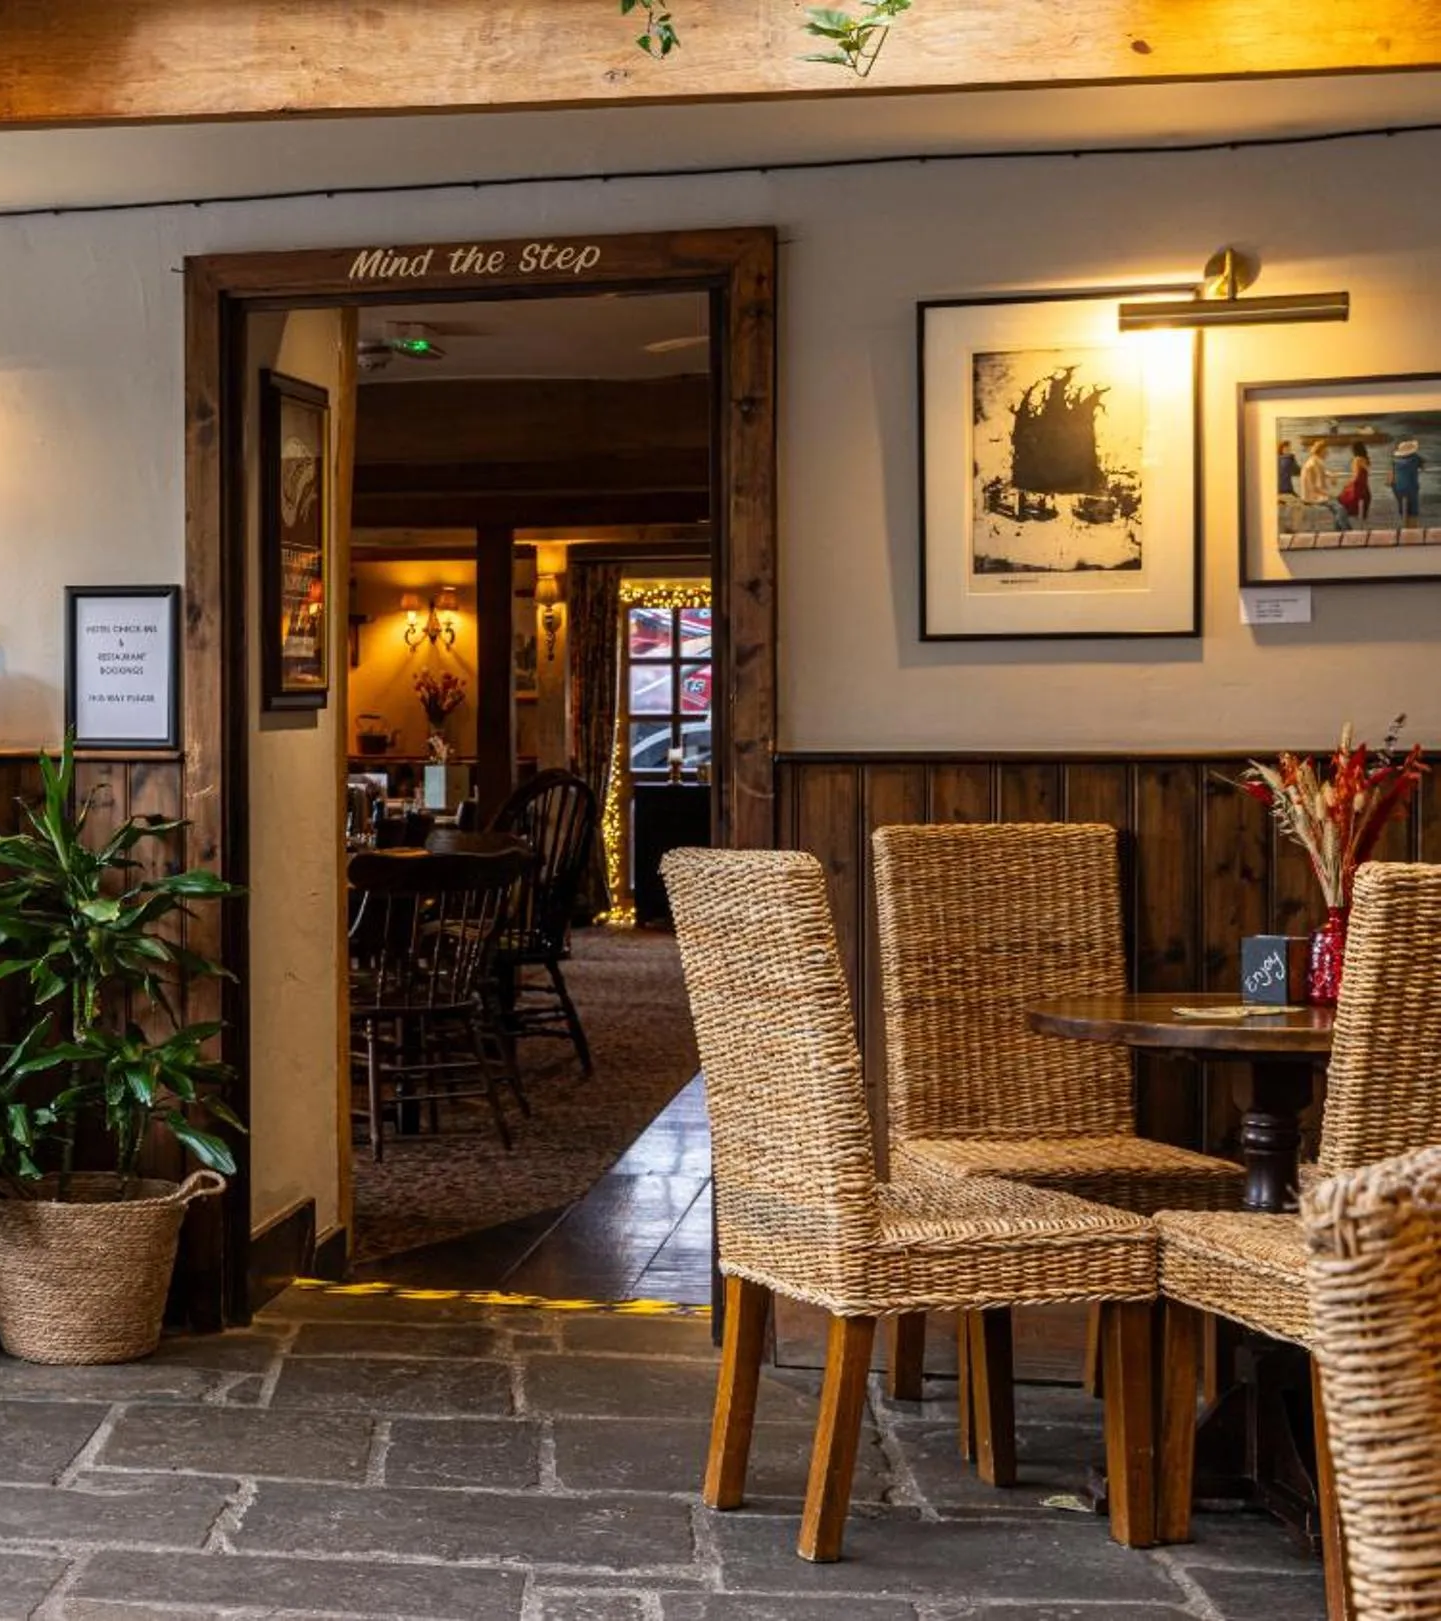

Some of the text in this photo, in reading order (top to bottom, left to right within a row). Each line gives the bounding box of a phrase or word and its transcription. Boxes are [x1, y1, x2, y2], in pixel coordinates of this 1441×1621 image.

[348, 243, 601, 281] Mind the Step
[97, 653, 147, 661] RESTAURANT
[100, 666, 144, 675] BOOKINGS
